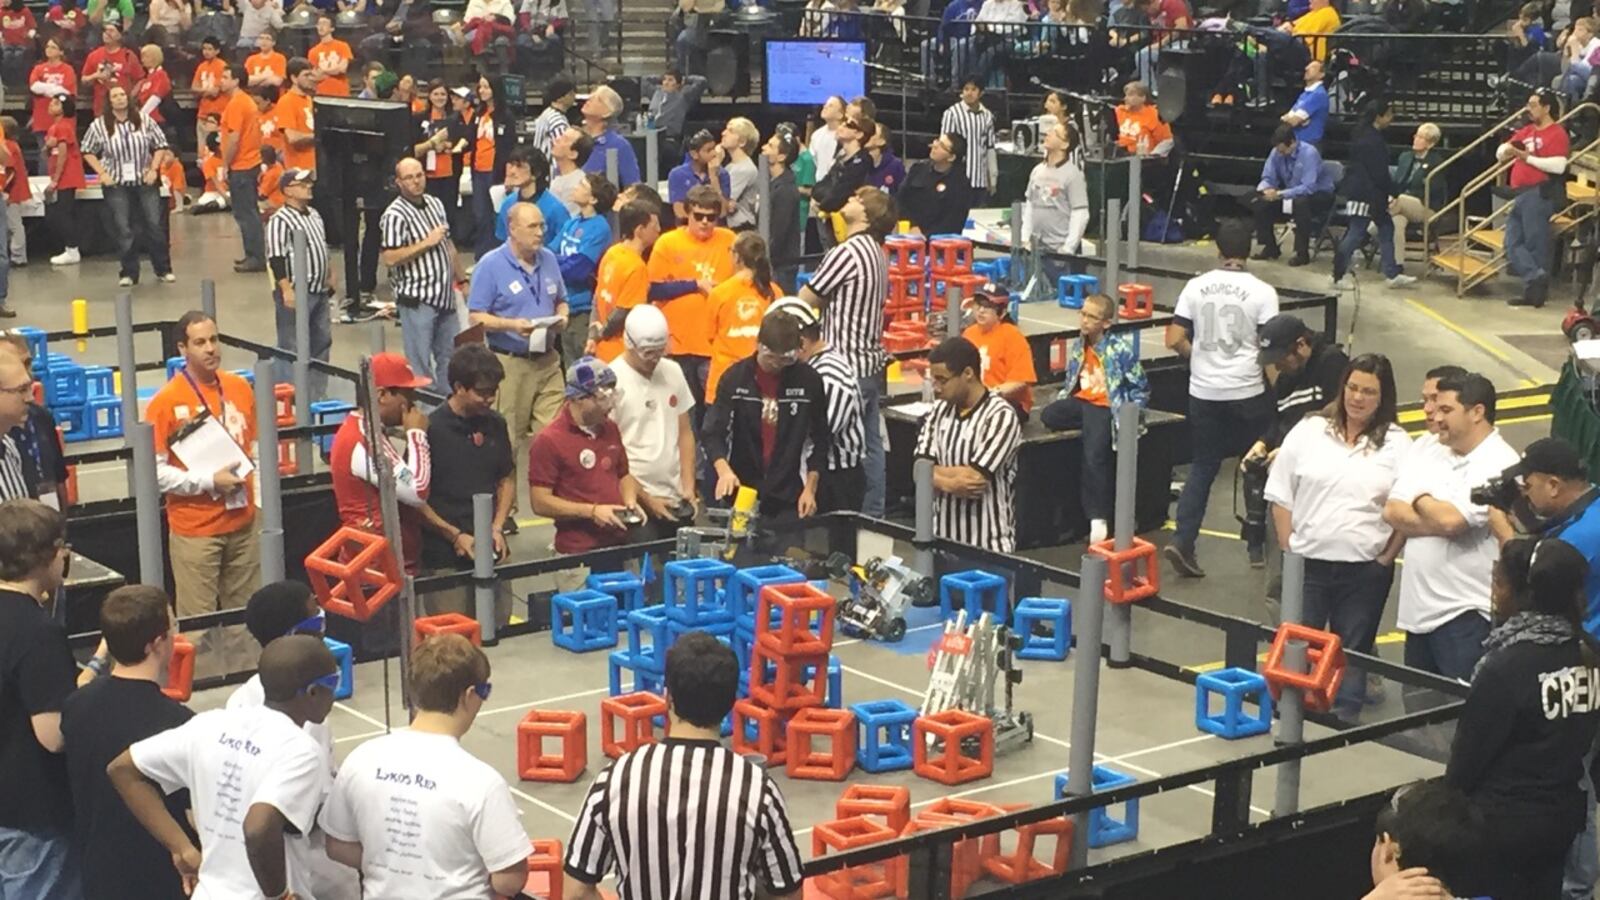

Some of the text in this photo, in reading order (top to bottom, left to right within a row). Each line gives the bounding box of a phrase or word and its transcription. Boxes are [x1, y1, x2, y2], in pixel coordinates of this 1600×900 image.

[1200, 283, 1250, 302] MORGAN
[1199, 302, 1246, 355] 13
[790, 402, 798, 416] 3
